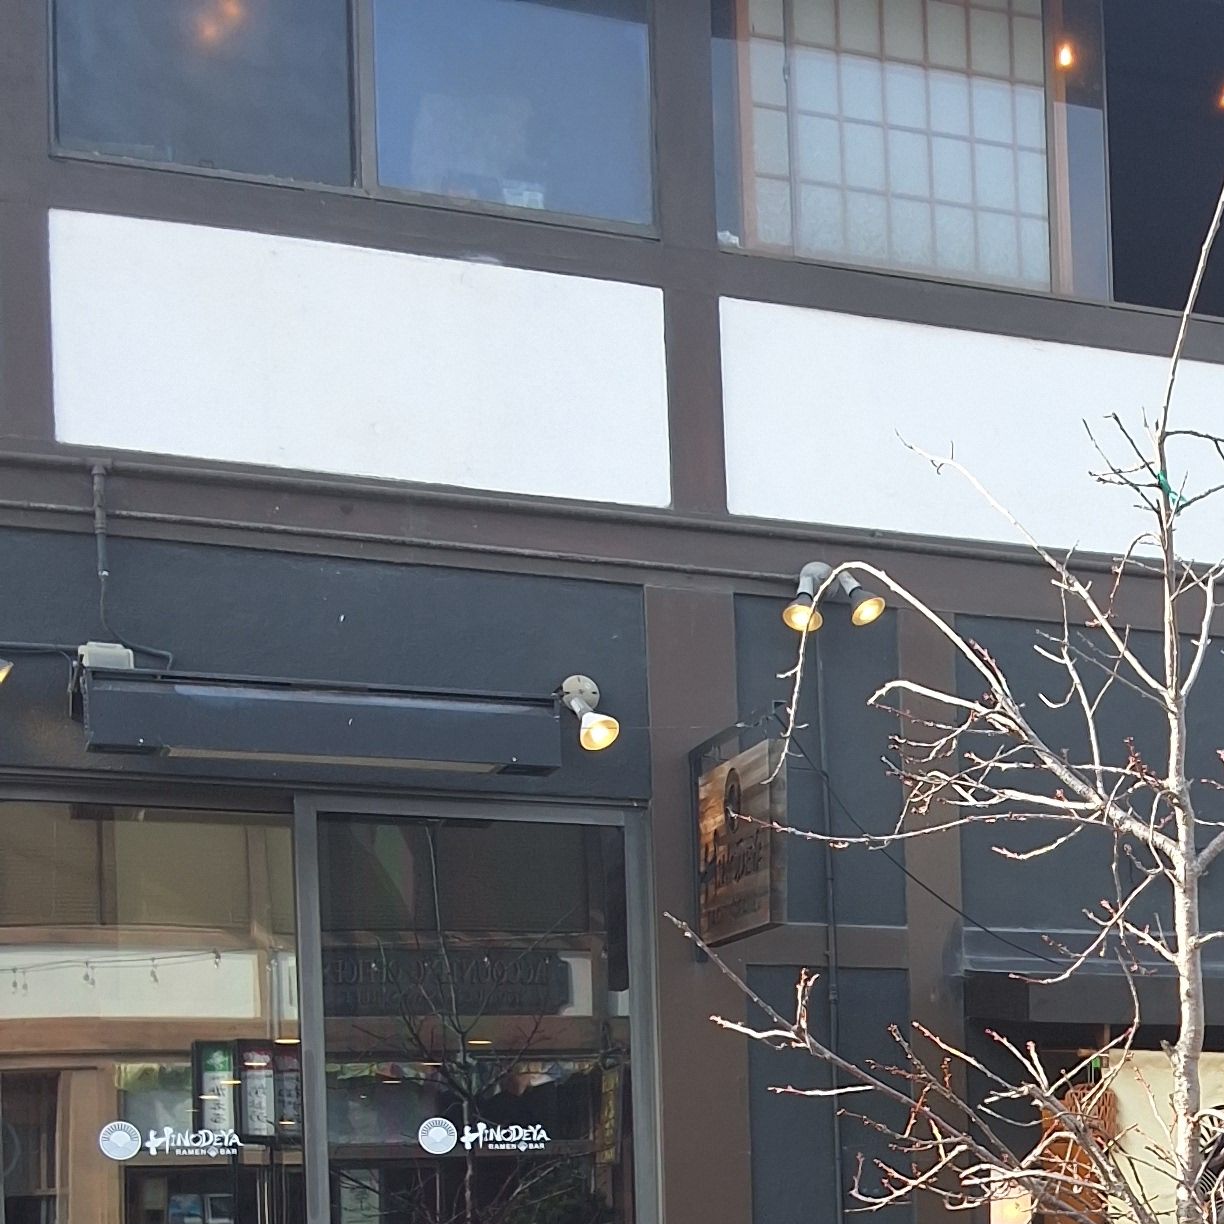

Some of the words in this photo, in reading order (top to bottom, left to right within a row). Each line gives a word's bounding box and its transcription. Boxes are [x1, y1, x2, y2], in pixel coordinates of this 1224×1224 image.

[145, 1126, 244, 1156] HINODEYA
[460, 1121, 551, 1150] HINODEYA
[175, 1148, 206, 1156] RAMEN
[220, 1148, 238, 1156] BAR
[529, 1142, 545, 1150] BAR
